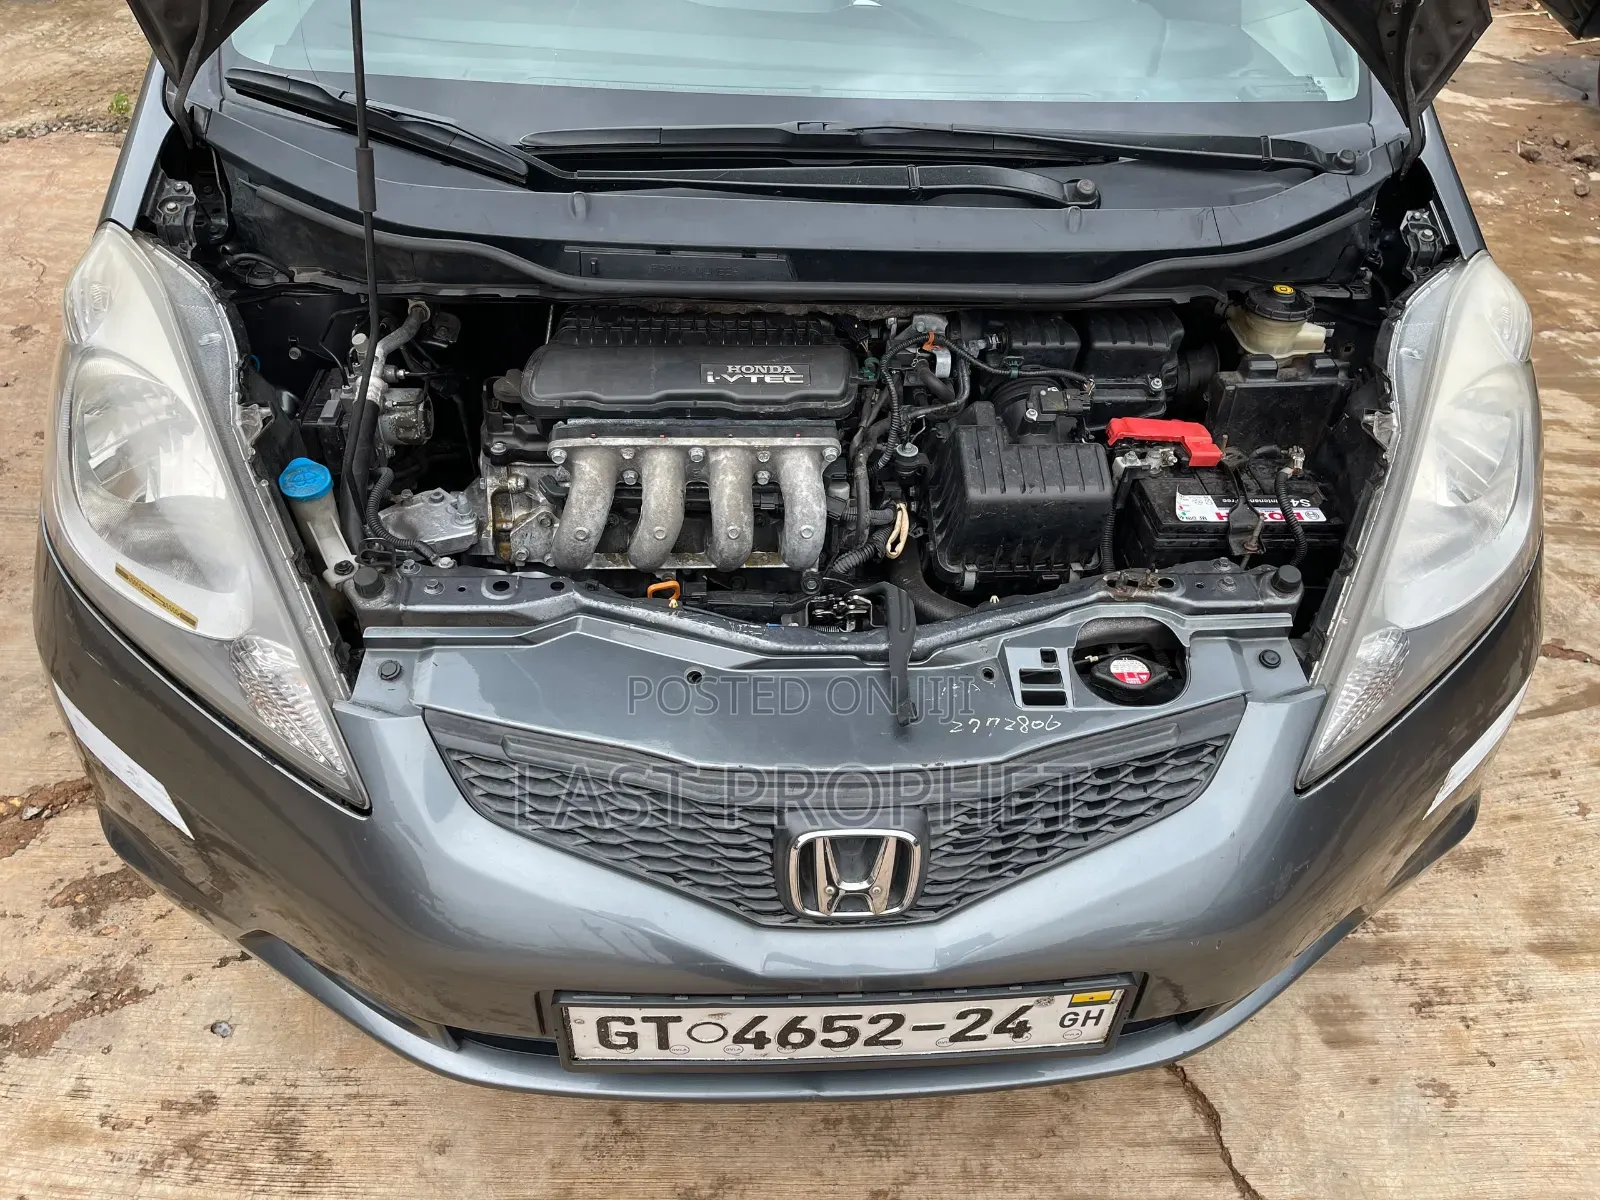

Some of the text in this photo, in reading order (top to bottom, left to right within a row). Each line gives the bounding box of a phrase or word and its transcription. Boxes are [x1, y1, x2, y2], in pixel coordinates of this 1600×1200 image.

[726, 365, 796, 374] HONDA
[706, 371, 804, 384] i-VTEC
[1289, 498, 1312, 507] S4
[1059, 1009, 1104, 1029] GH
[731, 1004, 1034, 1050] 4652-24
